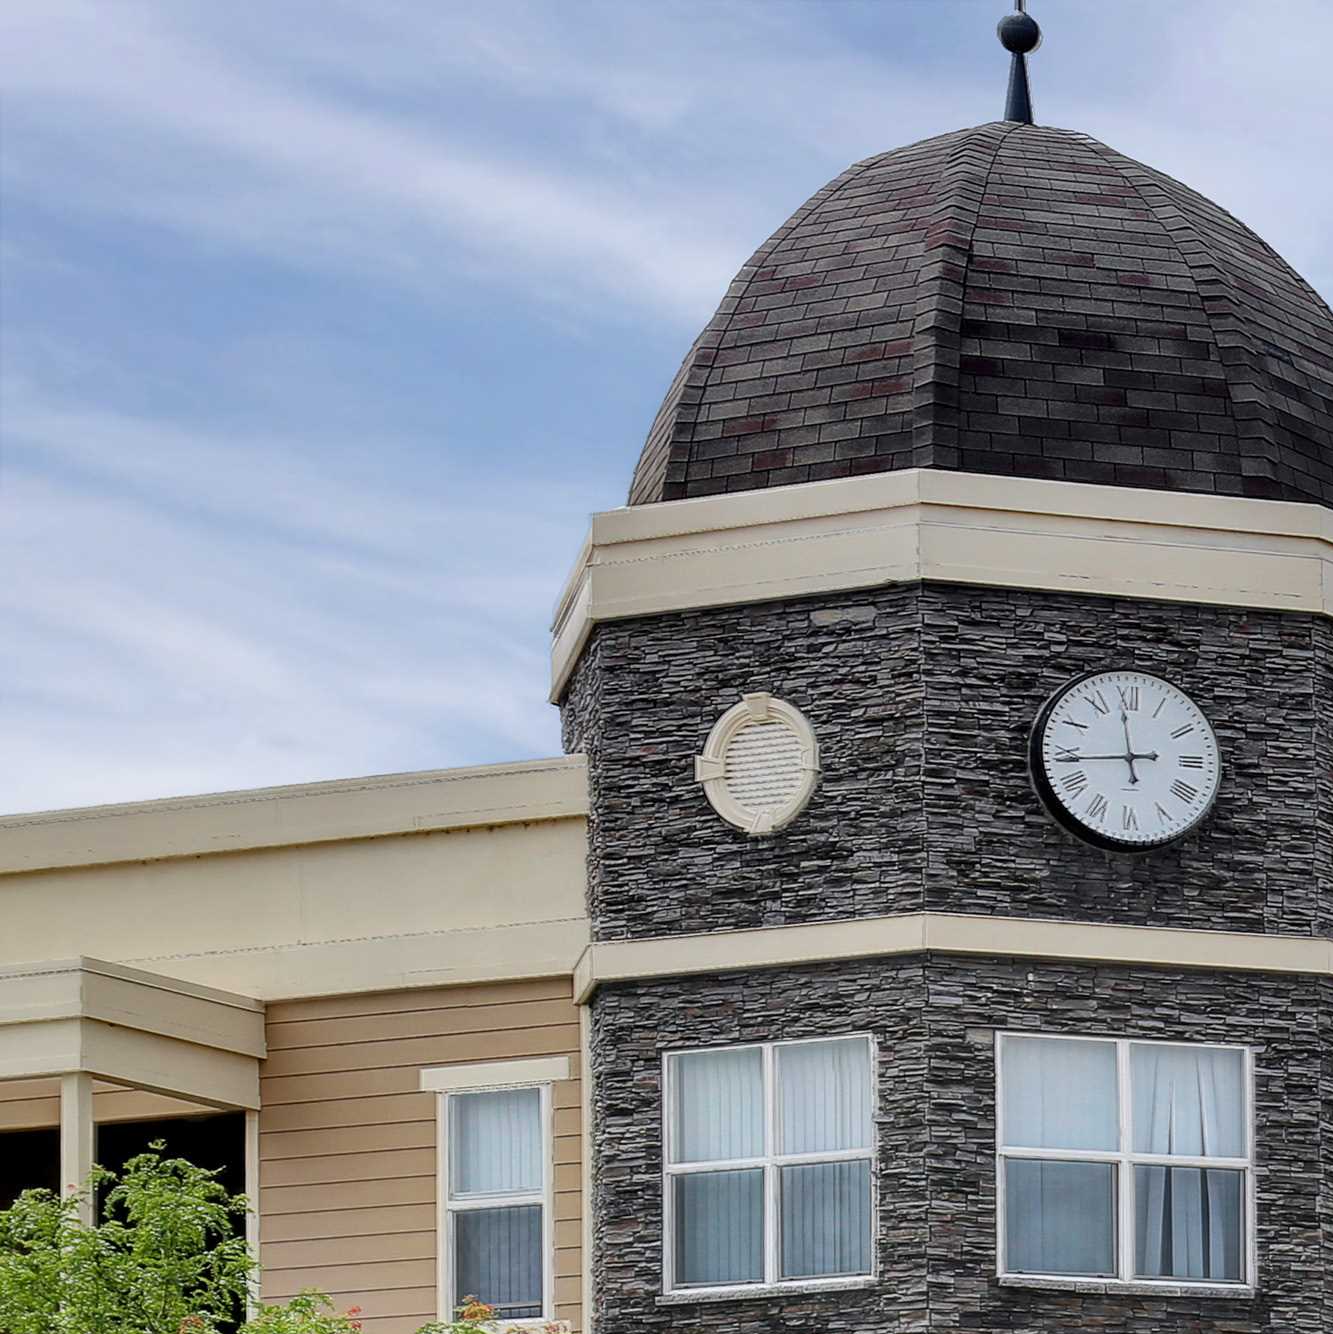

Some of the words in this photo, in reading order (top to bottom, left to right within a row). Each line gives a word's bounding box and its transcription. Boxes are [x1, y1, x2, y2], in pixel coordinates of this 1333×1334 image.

[1117, 686, 1139, 711] XII
[1152, 698, 1166, 718] I
[1170, 723, 1195, 740] II
[1179, 755, 1204, 769] III
[1060, 770, 1088, 800] VIII
[1169, 779, 1198, 804] IIII
